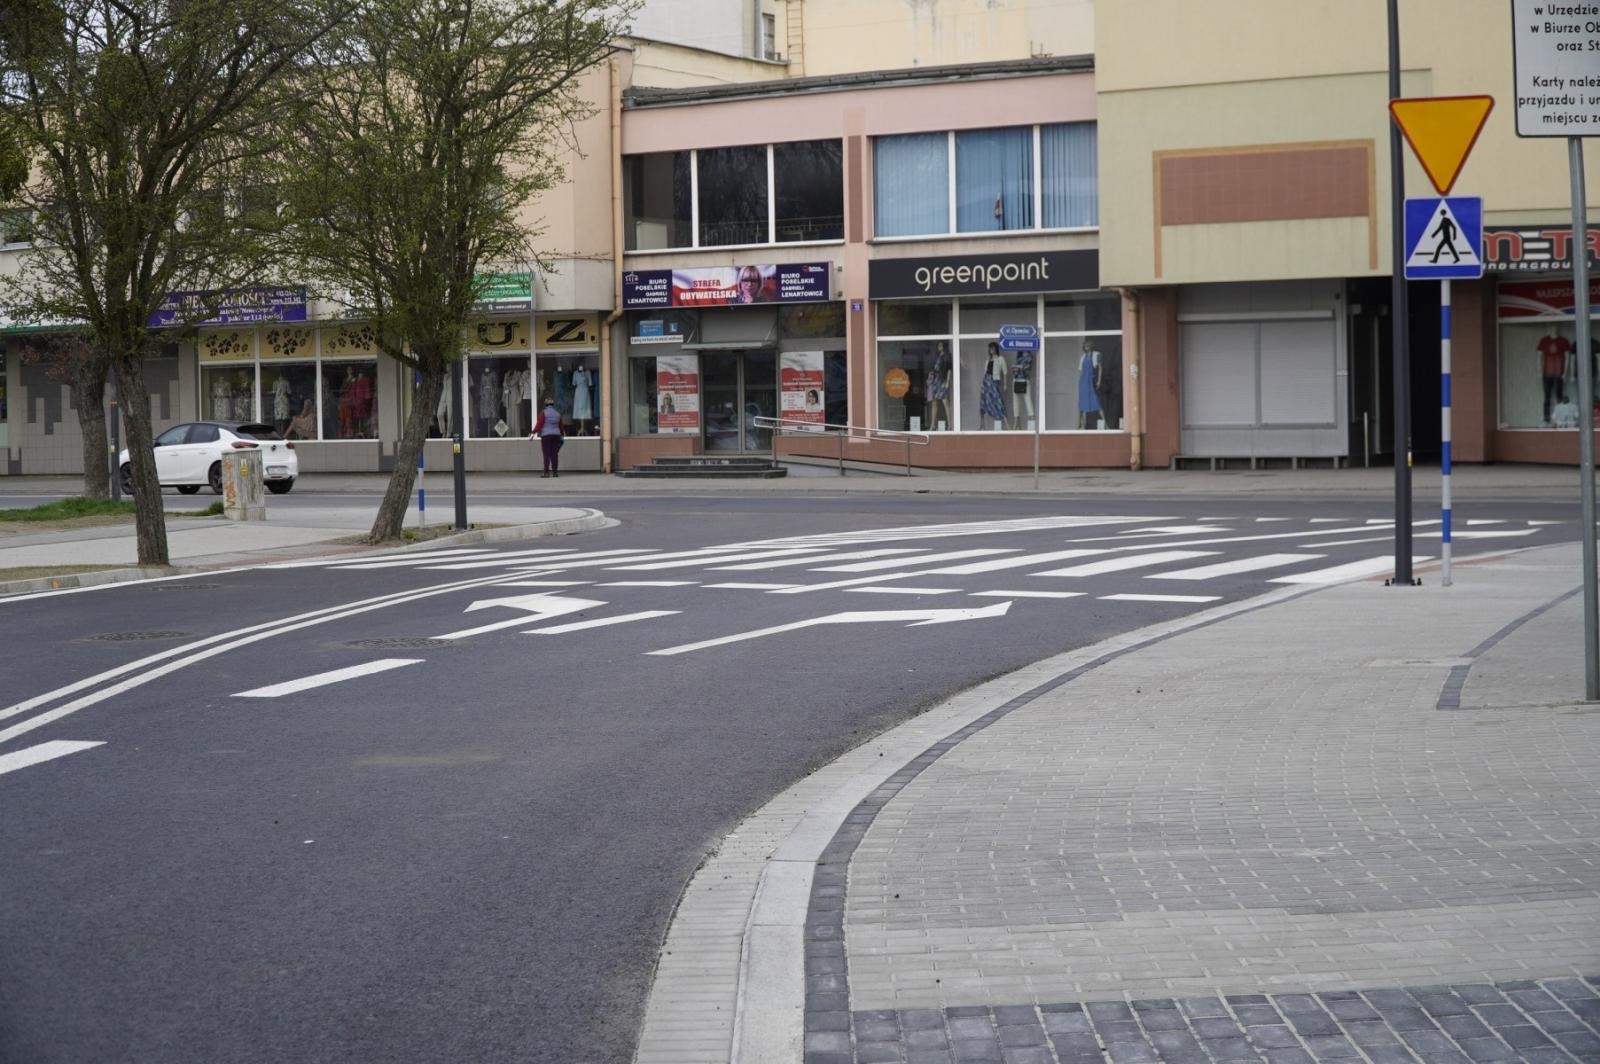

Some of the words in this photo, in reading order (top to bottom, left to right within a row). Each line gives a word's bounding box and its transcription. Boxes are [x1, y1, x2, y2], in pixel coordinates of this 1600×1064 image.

[1534, 7, 1543, 15] w
[1548, 4, 1599, 18] Urzędzie
[1531, 24, 1539, 33] w
[1544, 22, 1581, 33] Biurze
[1557, 43, 1583, 51] oraz
[1533, 76, 1564, 90] Karty
[1518, 94, 1575, 108] przyjazdu
[1543, 112, 1587, 125] miejscu
[915, 257, 1049, 292] greenpoint
[693, 279, 721, 288] STREFA
[680, 289, 737, 300] OBYWATELSKA
[546, 319, 596, 345] Z.
